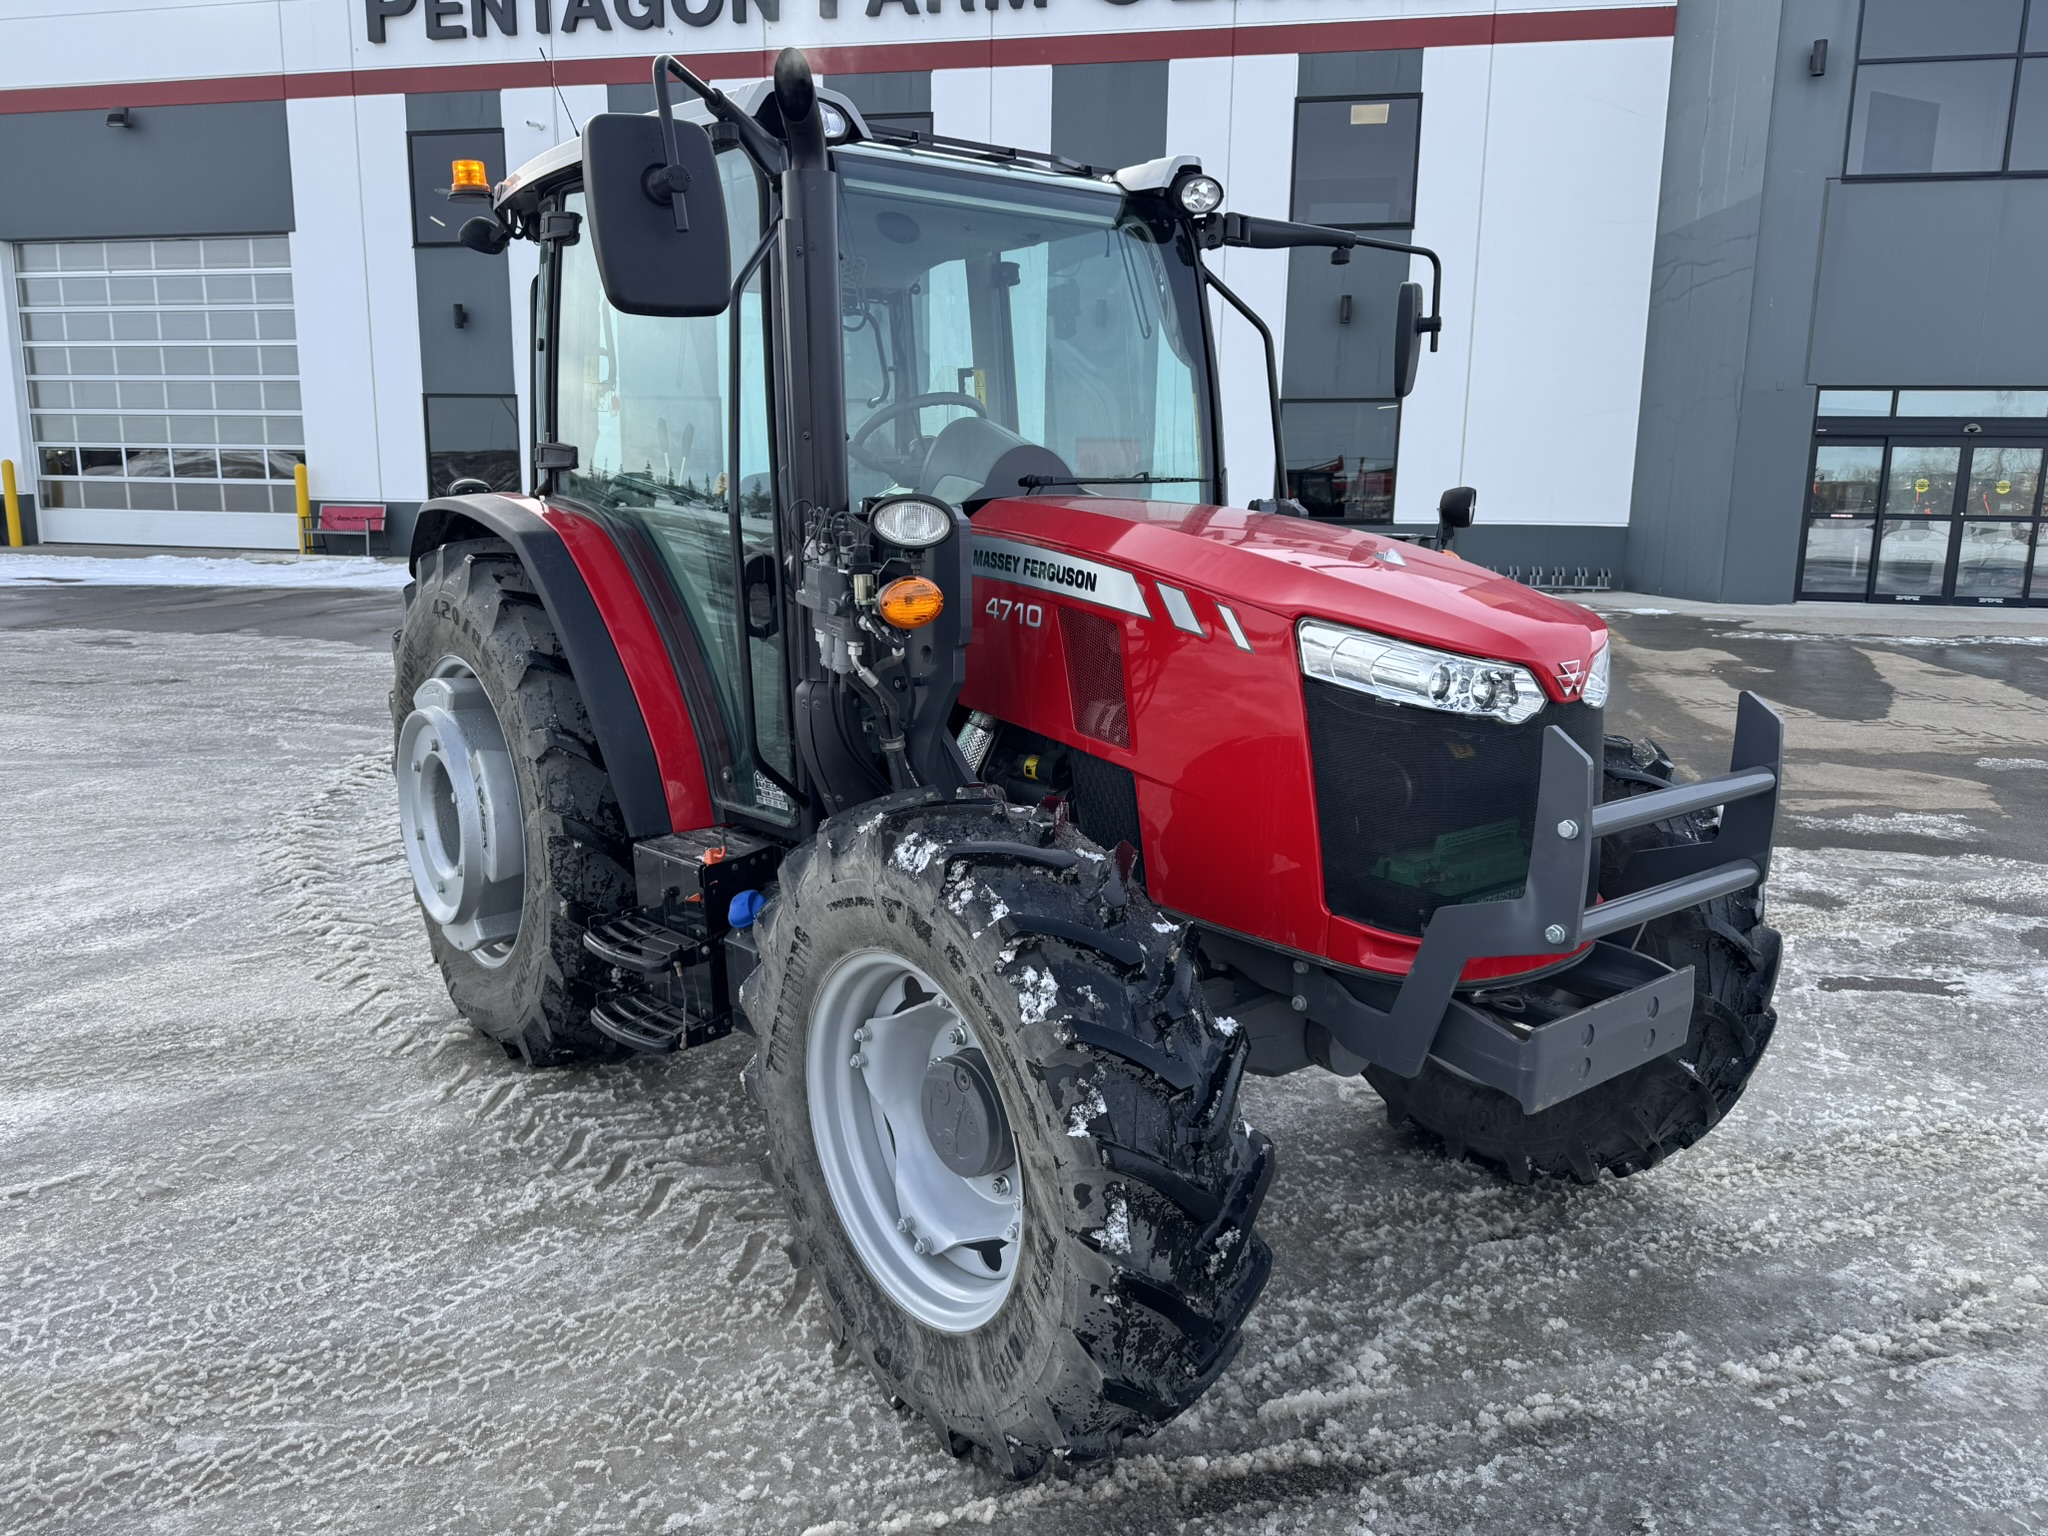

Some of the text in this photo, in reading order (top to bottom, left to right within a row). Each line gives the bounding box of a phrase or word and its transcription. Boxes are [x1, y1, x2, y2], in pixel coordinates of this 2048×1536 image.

[973, 549, 1098, 592] MASSEY FERGUSON
[985, 597, 1042, 628] 4710
[764, 925, 815, 1076] TRELLEBORG
